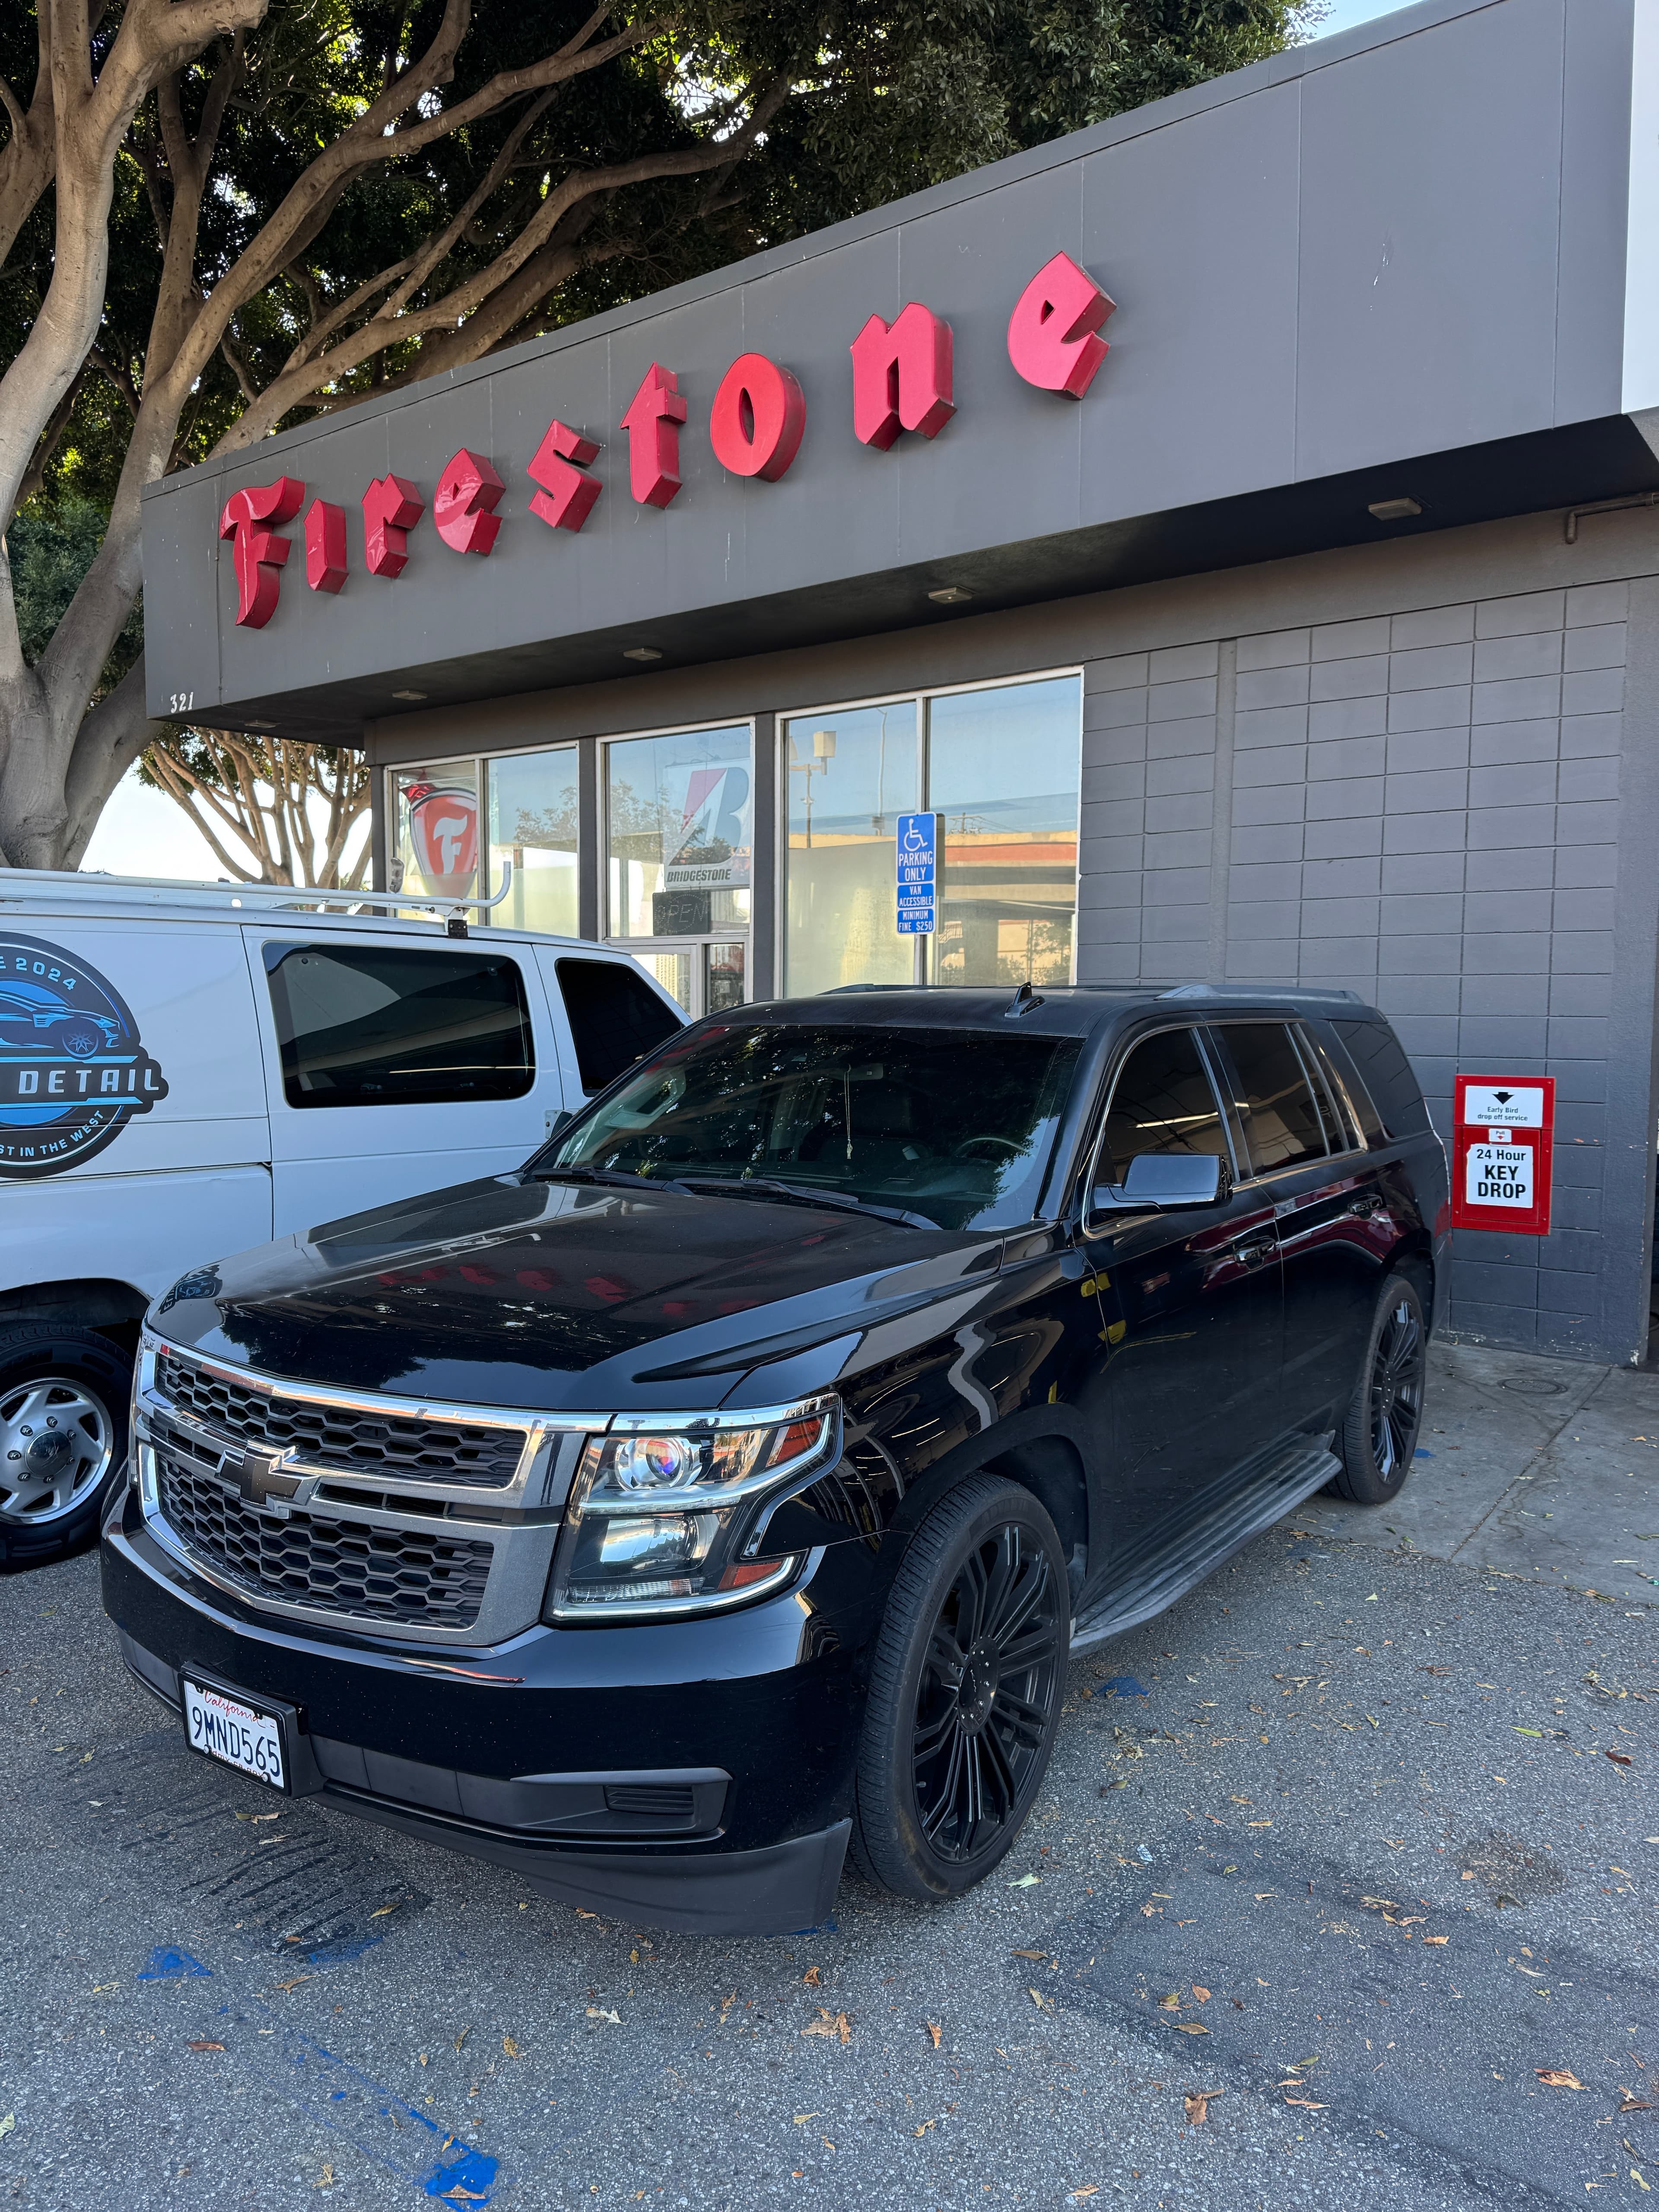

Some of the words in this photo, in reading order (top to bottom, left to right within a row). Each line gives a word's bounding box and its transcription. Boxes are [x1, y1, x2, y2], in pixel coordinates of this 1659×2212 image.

[219, 251, 1117, 630] Firestone
[170, 692, 194, 713] 321
[899, 851, 933, 867] PARKING
[667, 869, 732, 882] BRIDGESTONE
[905, 867, 927, 882] ONLY
[909, 885, 922, 895] VAN
[899, 896, 932, 907] ACCESSIBLE
[655, 902, 705, 924] OPEN
[903, 910, 928, 920] MINIMUM
[899, 922, 912, 931] FINE
[916, 921, 932, 931] $250
[16, 957, 76, 990] 2024
[18, 1069, 159, 1094] DETAIL
[20, 1147, 34, 1157] IN
[40, 1139, 68, 1155] THE
[70, 1110, 104, 1142] WEST
[1476, 1149, 1492, 1160] 24
[1497, 1149, 1526, 1161] Hour
[1484, 1164, 1519, 1181] KEY
[1478, 1182, 1526, 1199] DROP
[204, 1689, 266, 1728] California
[192, 1706, 280, 1777] 9MND565
